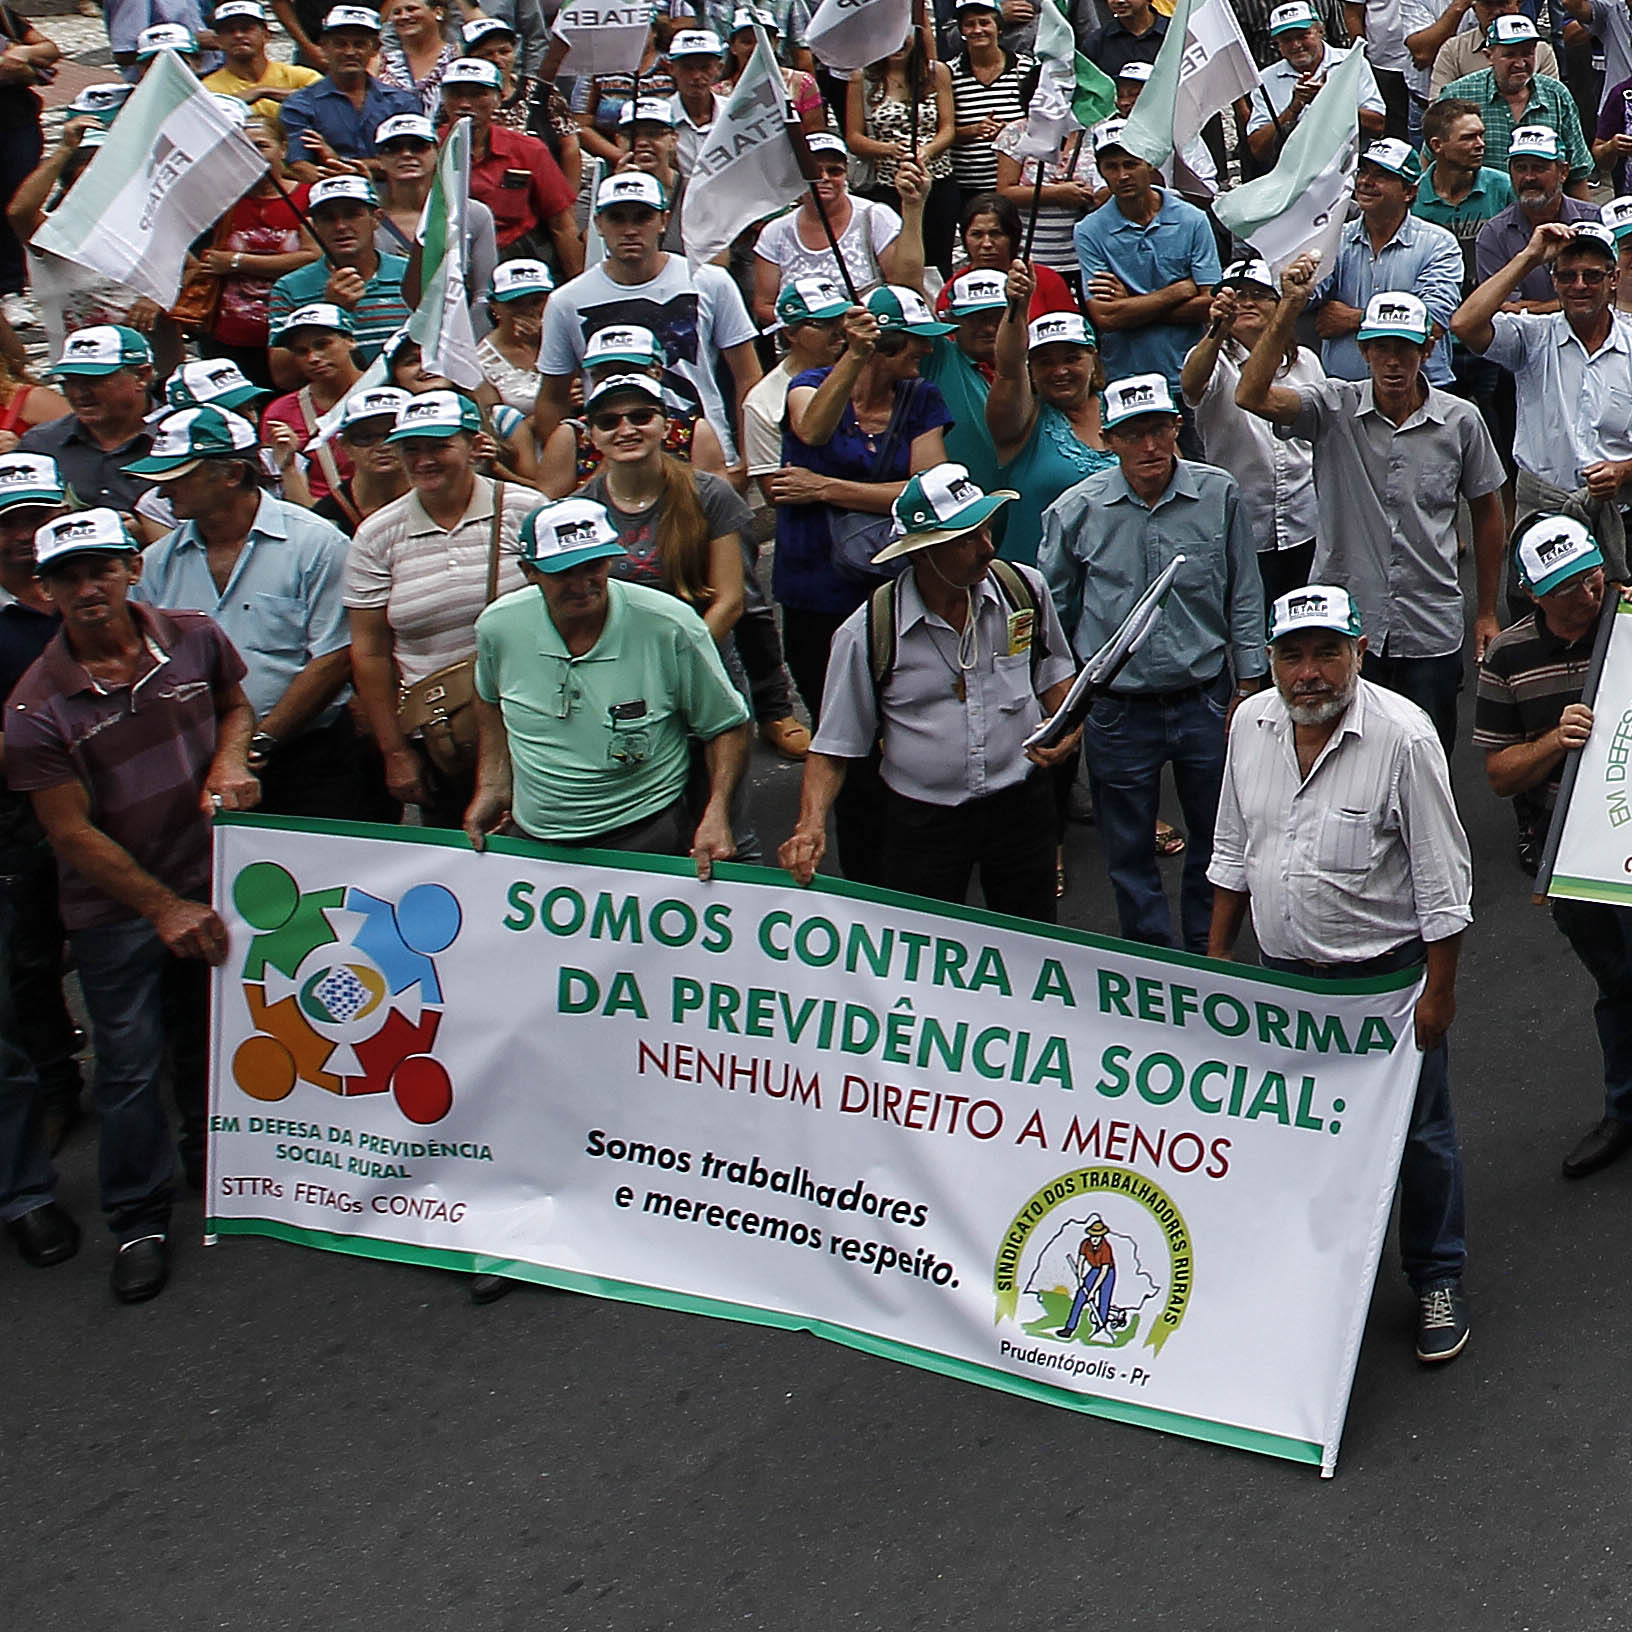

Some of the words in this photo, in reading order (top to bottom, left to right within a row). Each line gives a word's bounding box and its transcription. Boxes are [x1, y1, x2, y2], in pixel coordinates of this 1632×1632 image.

[1609, 804, 1632, 829] EM
[503, 881, 734, 954] SOMOS
[757, 909, 1012, 999] CONTRA
[1031, 959, 1075, 1009] A
[1100, 972, 1396, 1055] REFORMA
[558, 967, 650, 1021] DA
[671, 975, 1073, 1090] PREVIDÊNCIA
[1096, 1044, 1347, 1136] SOCIAL:
[210, 1114, 241, 1134] EM
[249, 1116, 323, 1141] DEFESA
[328, 1127, 354, 1144] DA
[359, 1132, 494, 1162] PREVIDÊNCIA
[636, 1040, 822, 1109] NENHUM
[840, 1076, 1003, 1141] DIREITO
[1016, 1109, 1048, 1150] A
[1062, 1121, 1232, 1179] MENOS
[221, 1176, 284, 1200] STTRs
[294, 1181, 364, 1213] FETAGs
[371, 1195, 467, 1224] CONTAG
[276, 1143, 343, 1171] SOCIAL
[347, 1155, 412, 1180] RURAL
[585, 1128, 692, 1174] Somos
[701, 1151, 929, 1228] trabalhadores
[614, 1186, 635, 1209] e
[643, 1192, 822, 1251] merecemos
[829, 1233, 961, 1289] respeito.
[998, 1202, 1044, 1291] SINDICATO
[1043, 1174, 1076, 1207] DOS
[1079, 1169, 1188, 1250] TRABALHADORES
[1163, 1253, 1190, 1326] RURAIS
[1000, 1339, 1117, 1382] Prudentópolis
[1130, 1366, 1151, 1386] Pr
